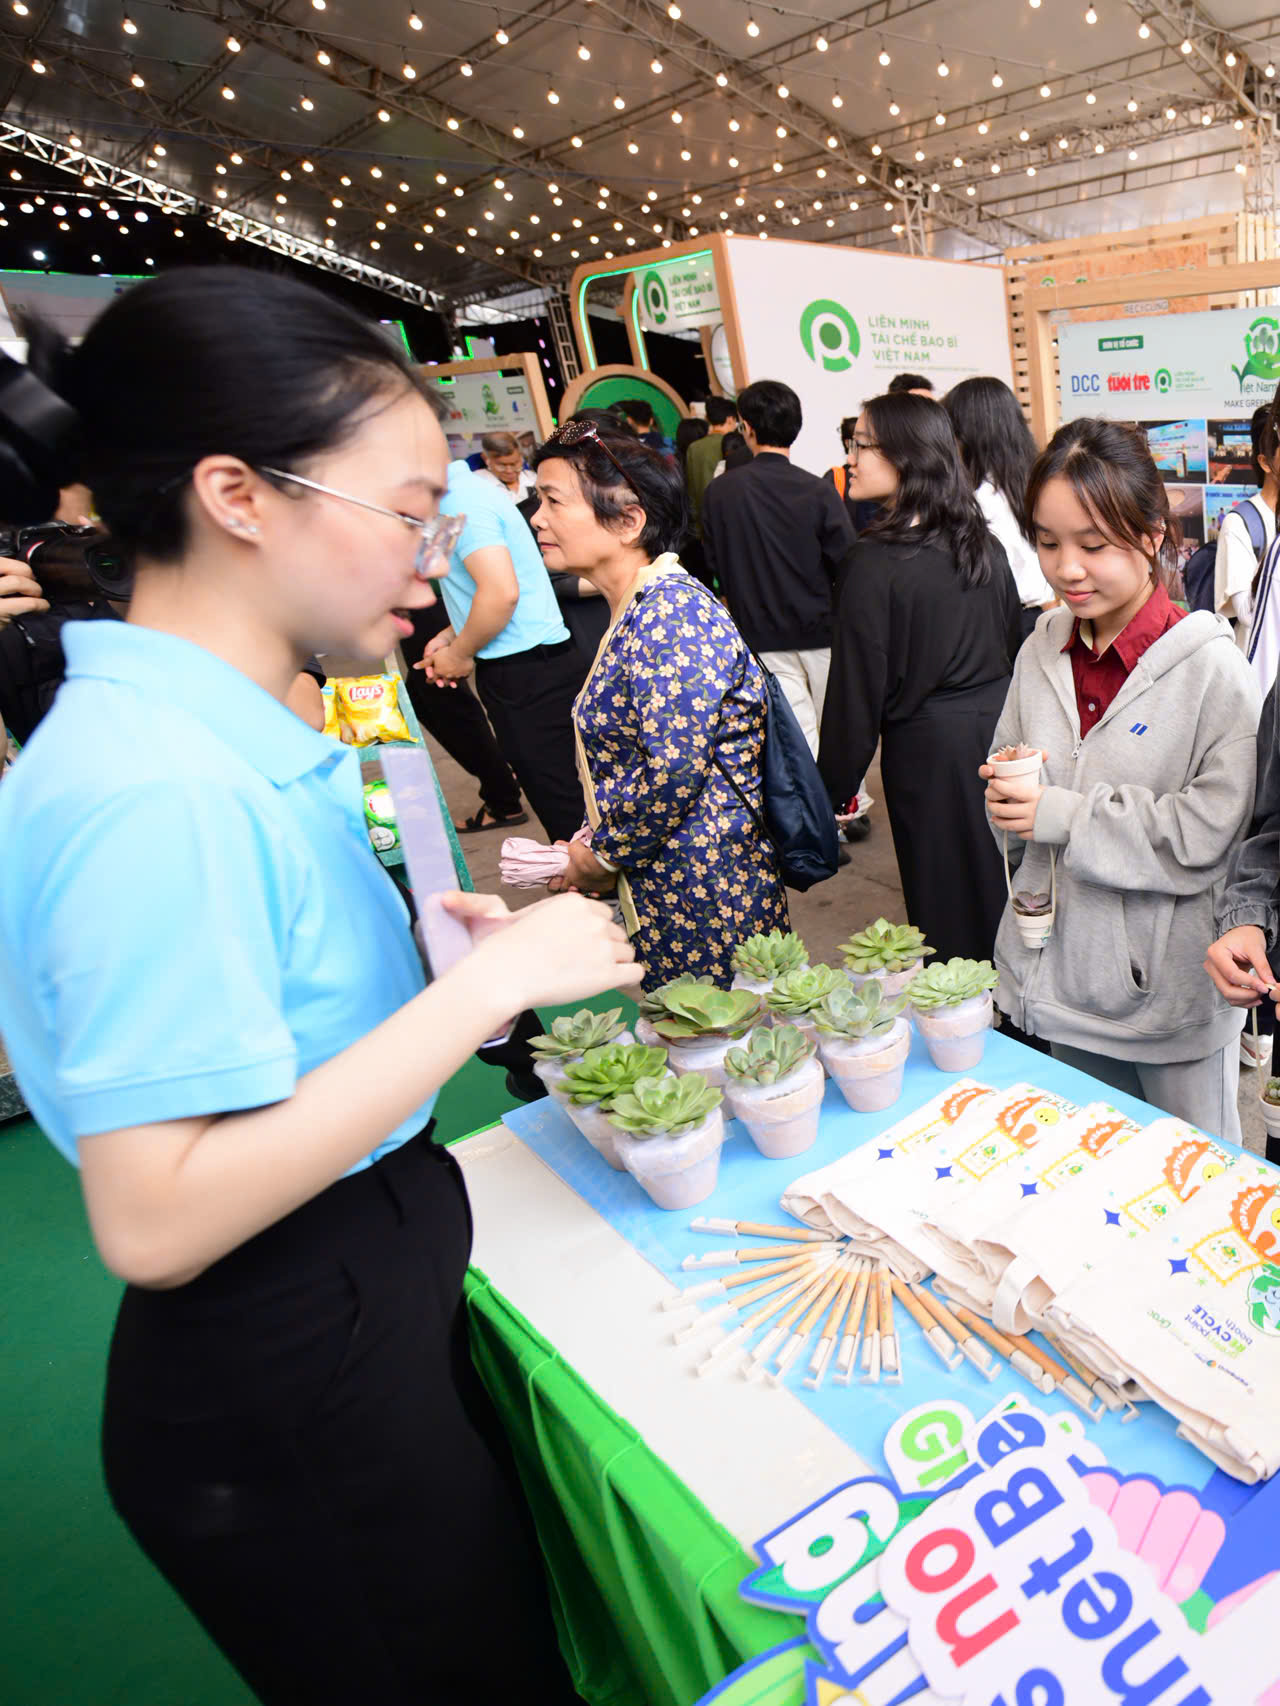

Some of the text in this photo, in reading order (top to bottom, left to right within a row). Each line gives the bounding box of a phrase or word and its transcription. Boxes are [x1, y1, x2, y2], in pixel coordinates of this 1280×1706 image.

[868, 314, 930, 331] LIÊN MINH
[920, 335, 945, 347] BAO
[947, 335, 958, 348] BÌ
[904, 351, 931, 361] NAM
[1071, 374, 1100, 393] DCC
[905, 1527, 1021, 1669] no
